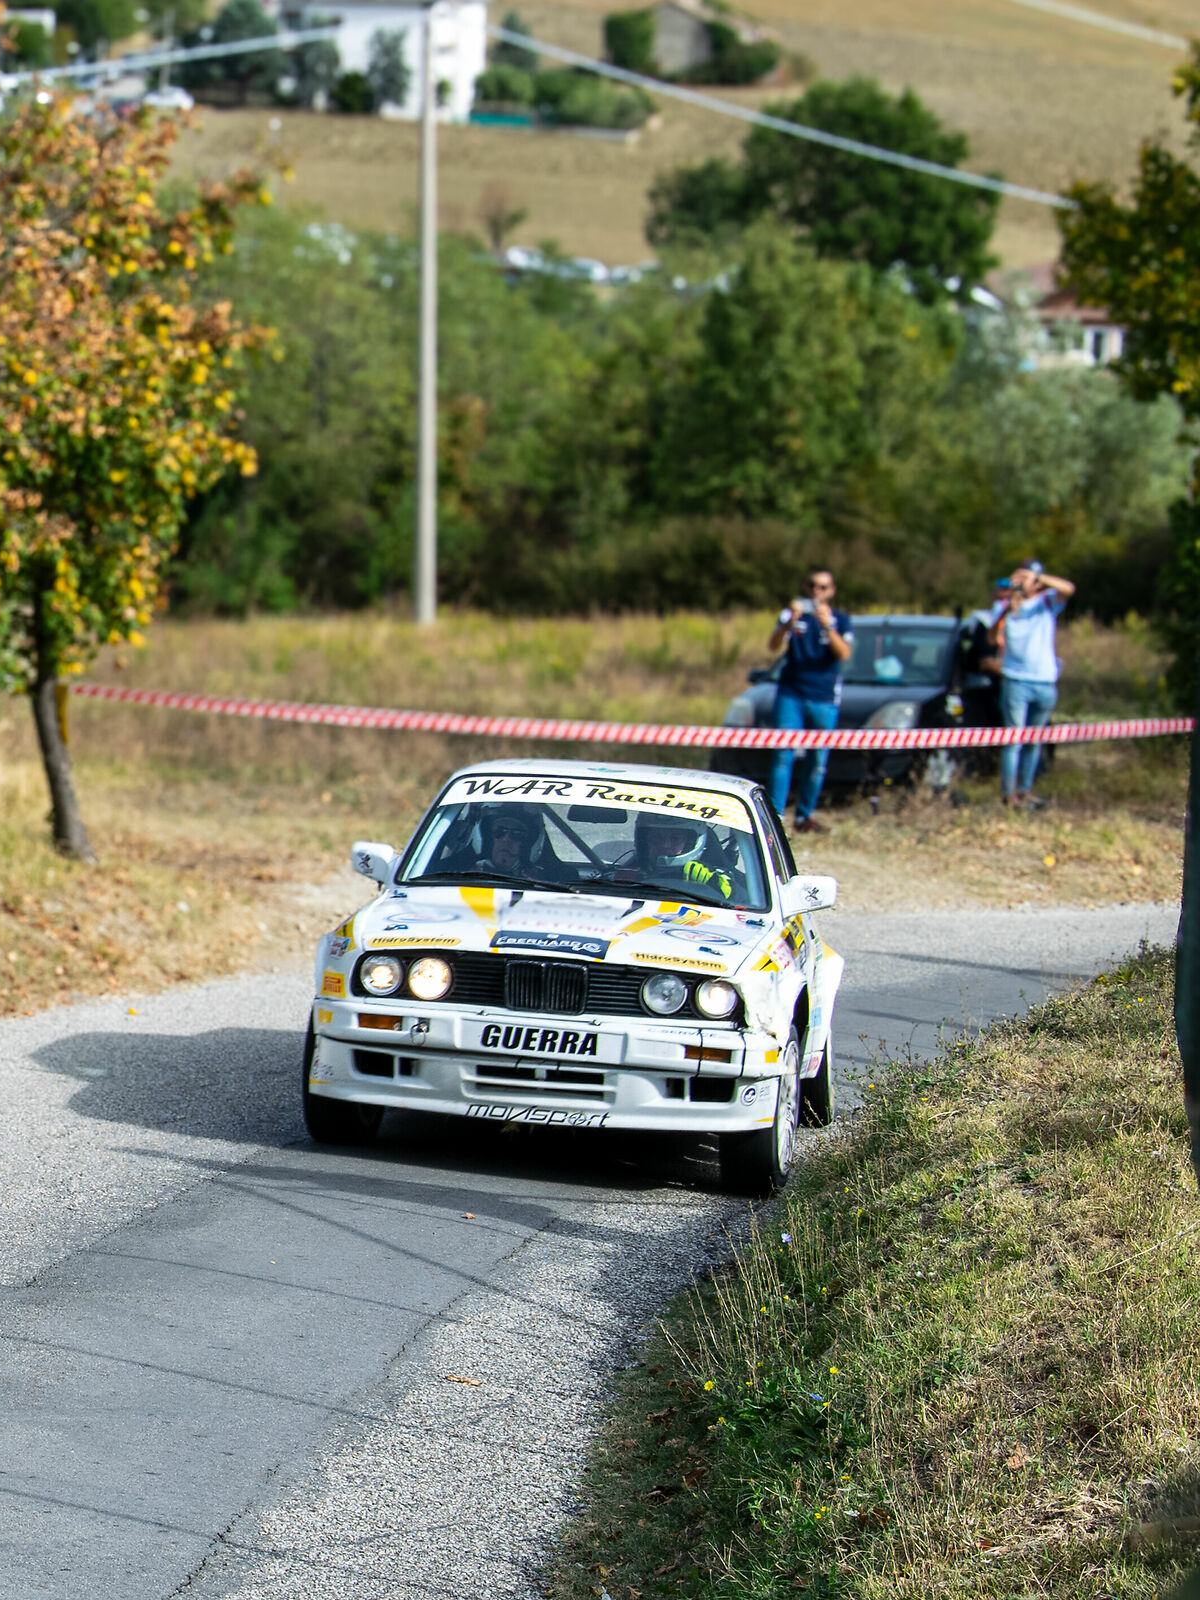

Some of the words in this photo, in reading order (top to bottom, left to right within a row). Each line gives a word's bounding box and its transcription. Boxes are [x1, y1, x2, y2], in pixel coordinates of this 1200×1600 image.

[464, 779, 573, 797] WAR
[585, 783, 723, 819] Racing
[480, 1023, 599, 1057] GUERRA
